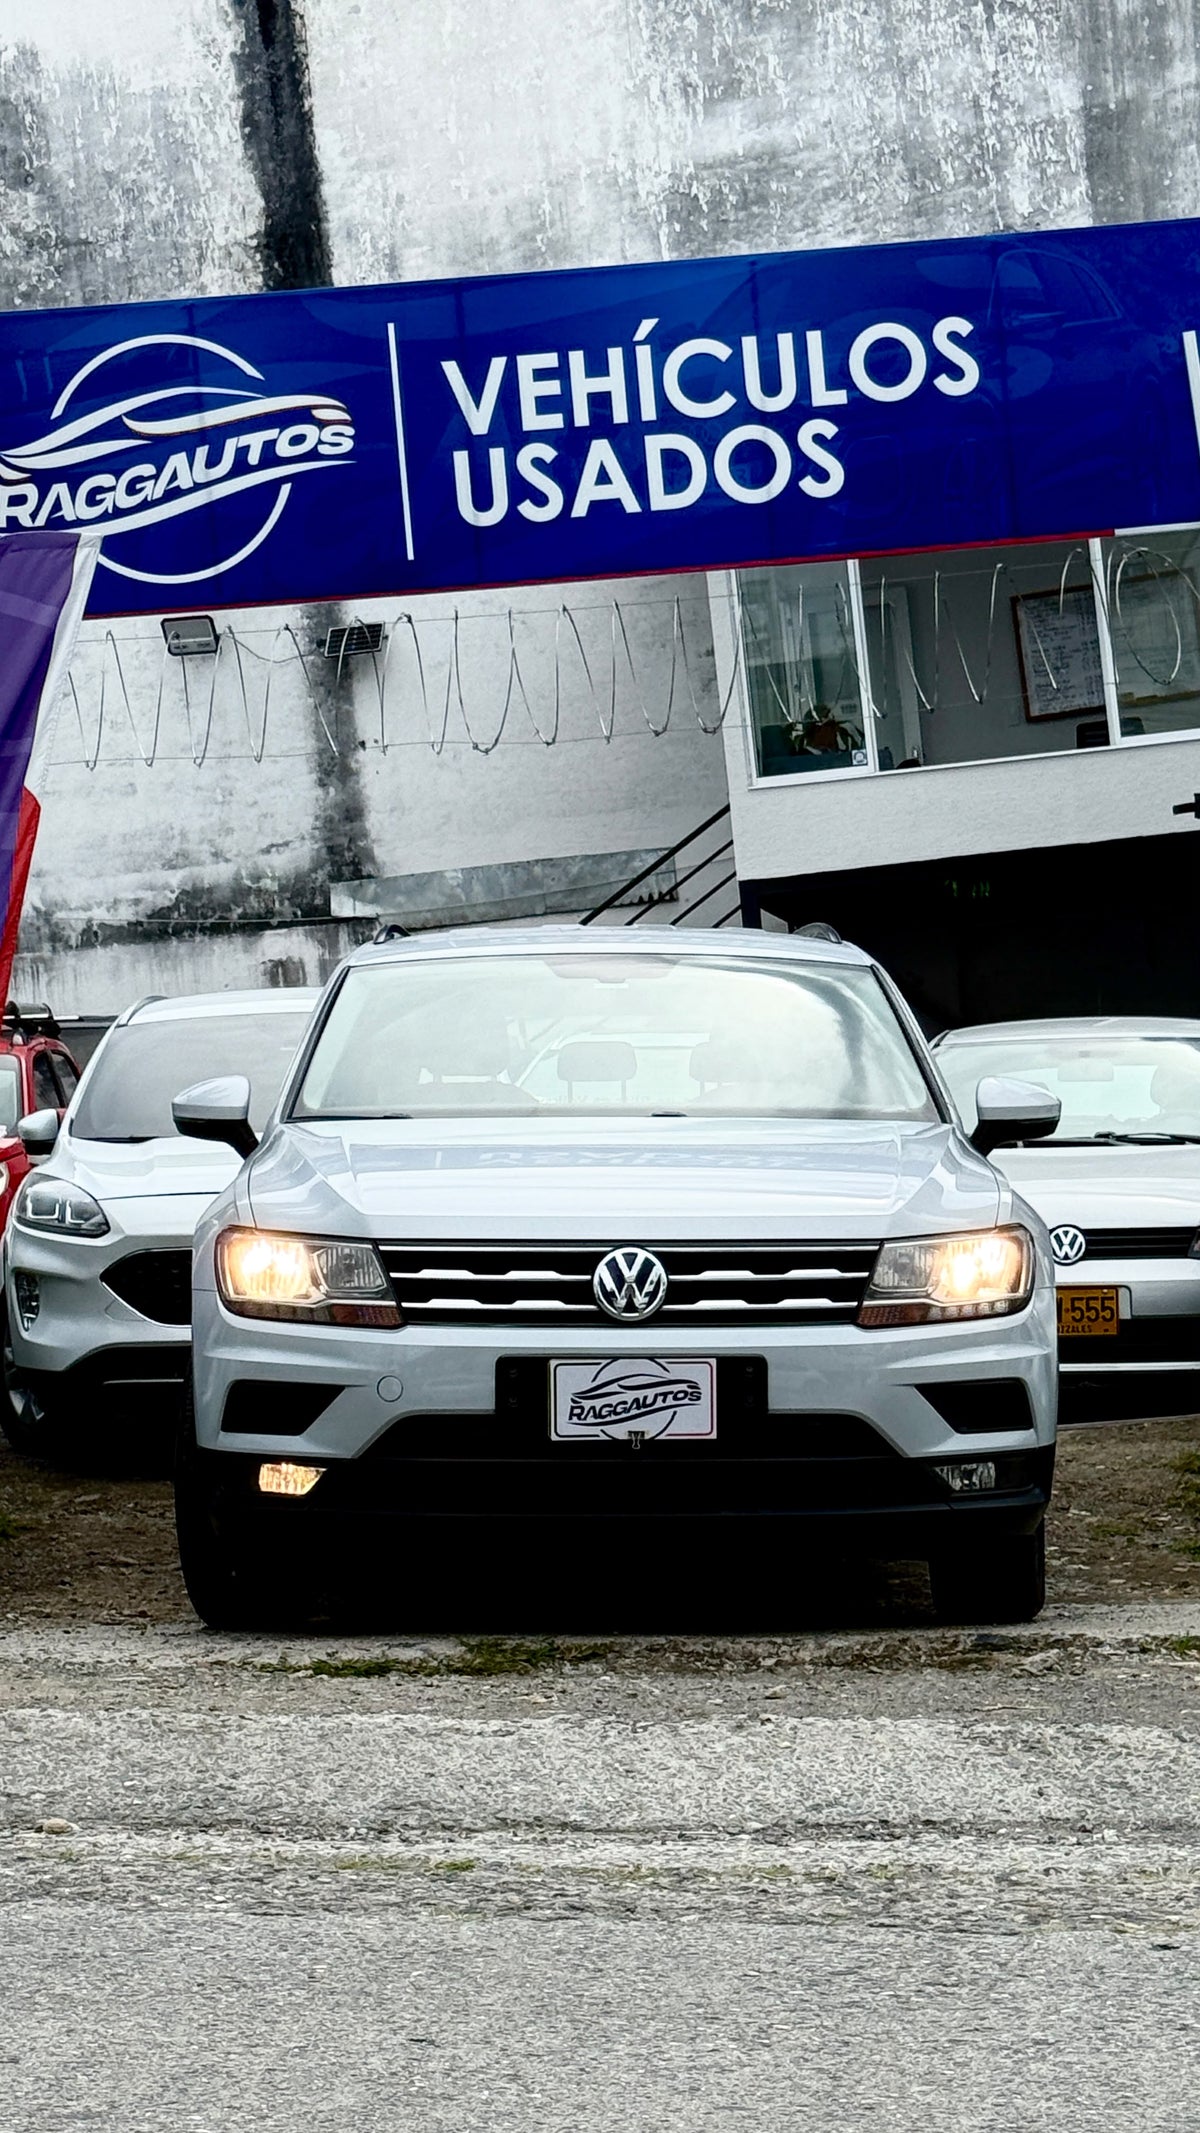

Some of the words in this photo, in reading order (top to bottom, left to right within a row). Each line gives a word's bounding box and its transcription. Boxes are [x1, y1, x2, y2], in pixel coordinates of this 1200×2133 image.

[440, 317, 981, 436] VEHÍCULOS
[0, 423, 356, 528] RAGGAUTOS
[453, 418, 845, 528] USADOS
[595, 1249, 667, 1319] VW
[567, 1389, 702, 1421] RAGGAUTOS
